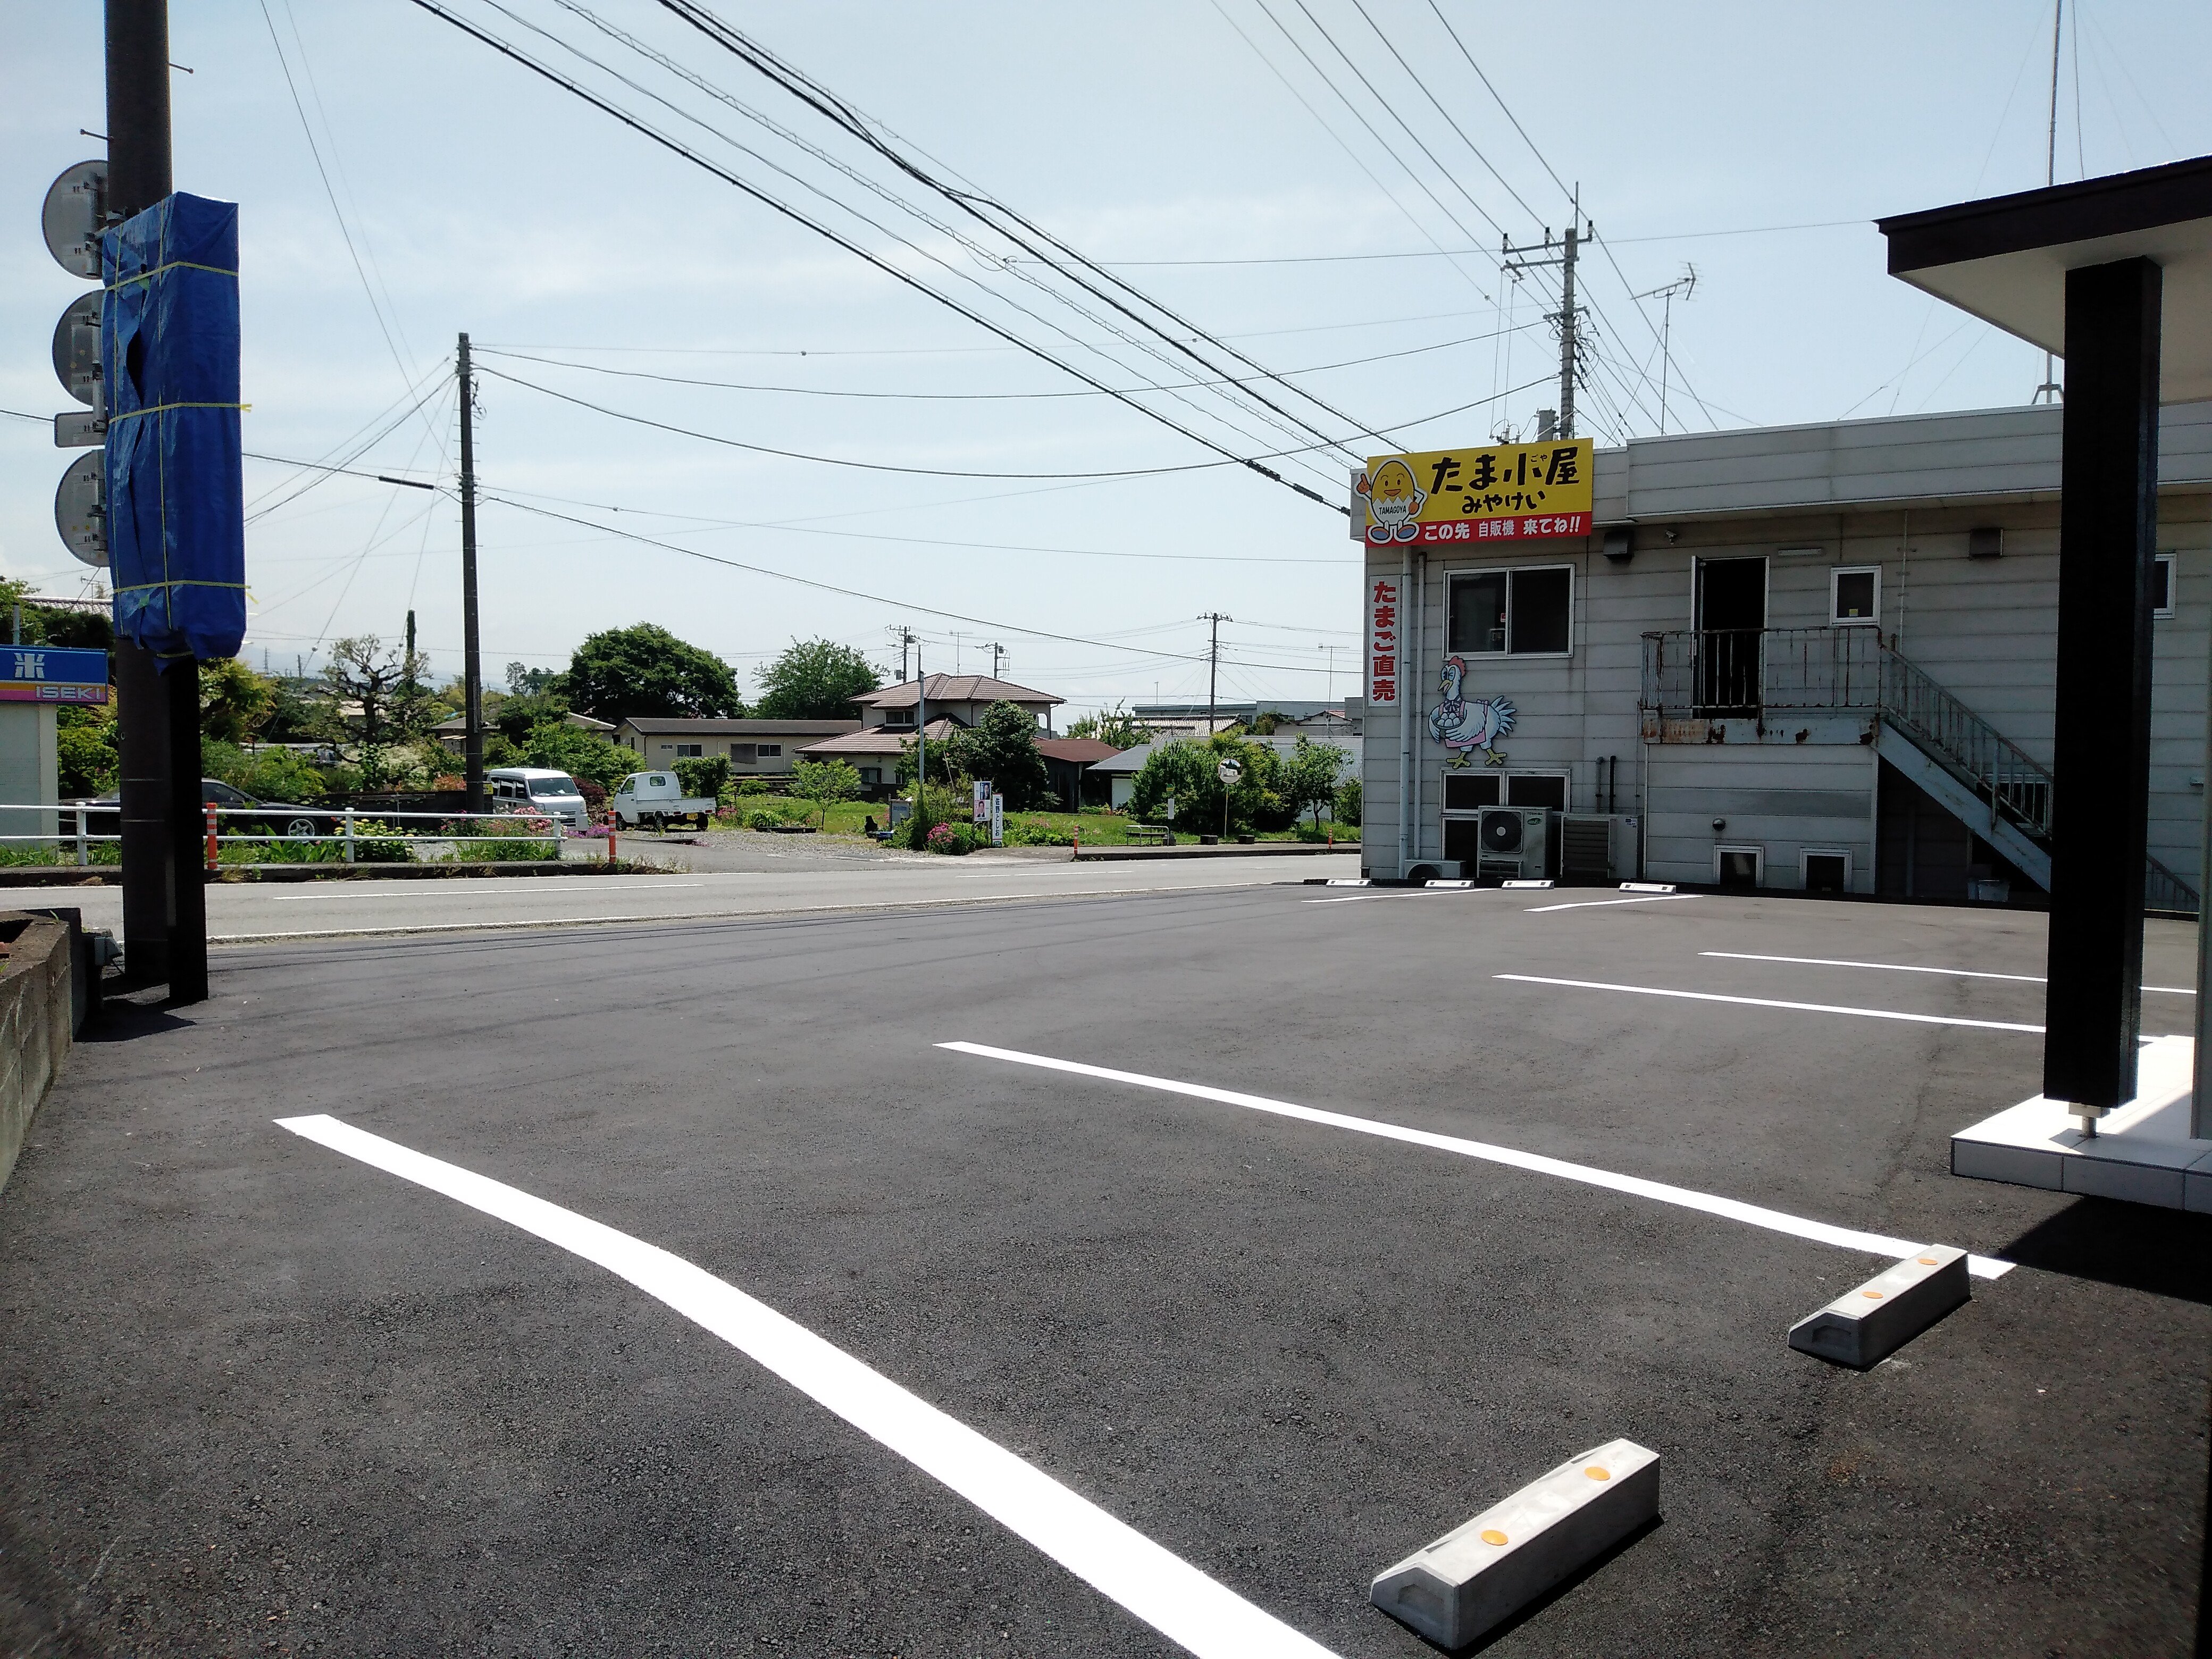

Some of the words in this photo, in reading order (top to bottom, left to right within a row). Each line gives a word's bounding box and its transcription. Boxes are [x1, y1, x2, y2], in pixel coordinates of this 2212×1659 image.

[1531, 454, 1548, 463] ごや
[1430, 447, 1580, 495] たま小屋
[1379, 505, 1406, 515] TAMAGOYA
[1462, 490, 1546, 514] みやけい
[1425, 522, 1470, 541] この先
[1478, 519, 1514, 538] 自販機
[1523, 516, 1581, 535] 来てね!!
[1372, 581, 1397, 702] たまご直売
[36, 686, 100, 700] ISEKI
